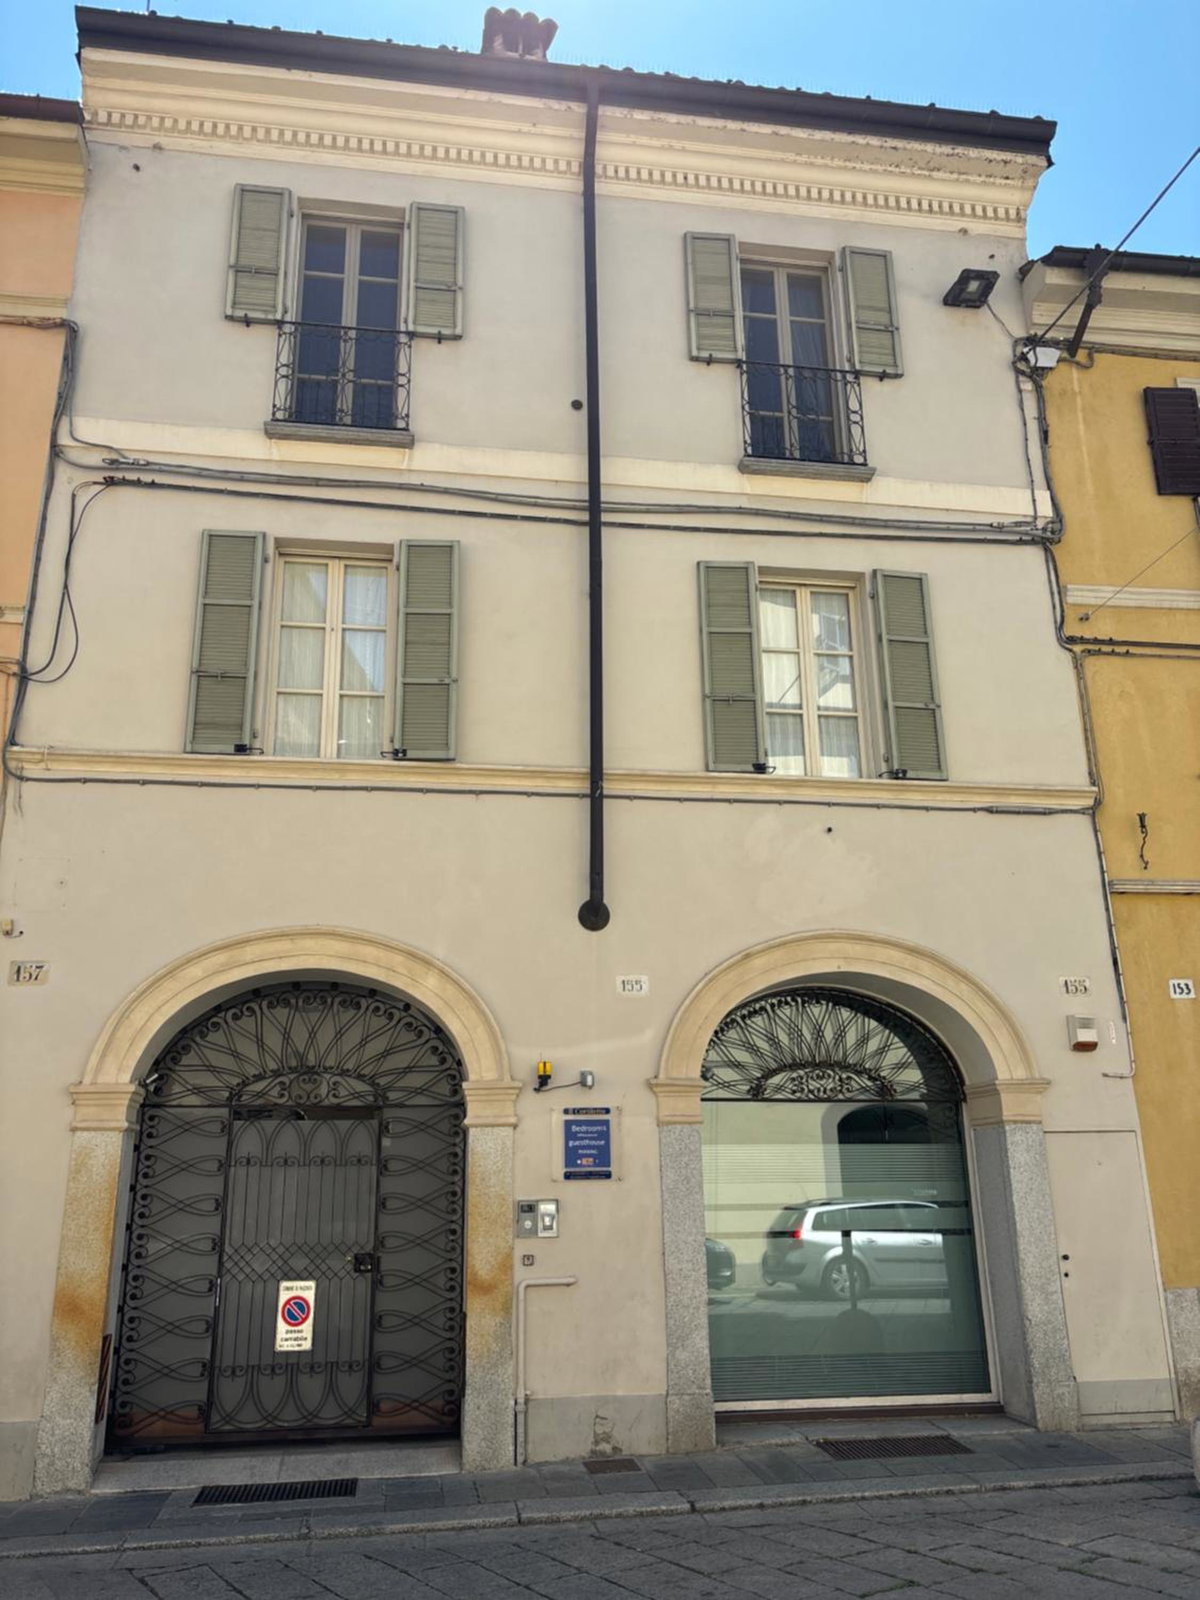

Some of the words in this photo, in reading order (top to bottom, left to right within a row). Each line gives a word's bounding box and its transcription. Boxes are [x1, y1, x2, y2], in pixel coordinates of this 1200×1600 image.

[15, 965, 44, 981] 157
[621, 979, 643, 993] 155
[1064, 979, 1088, 995] 155
[1172, 982, 1192, 995] 153
